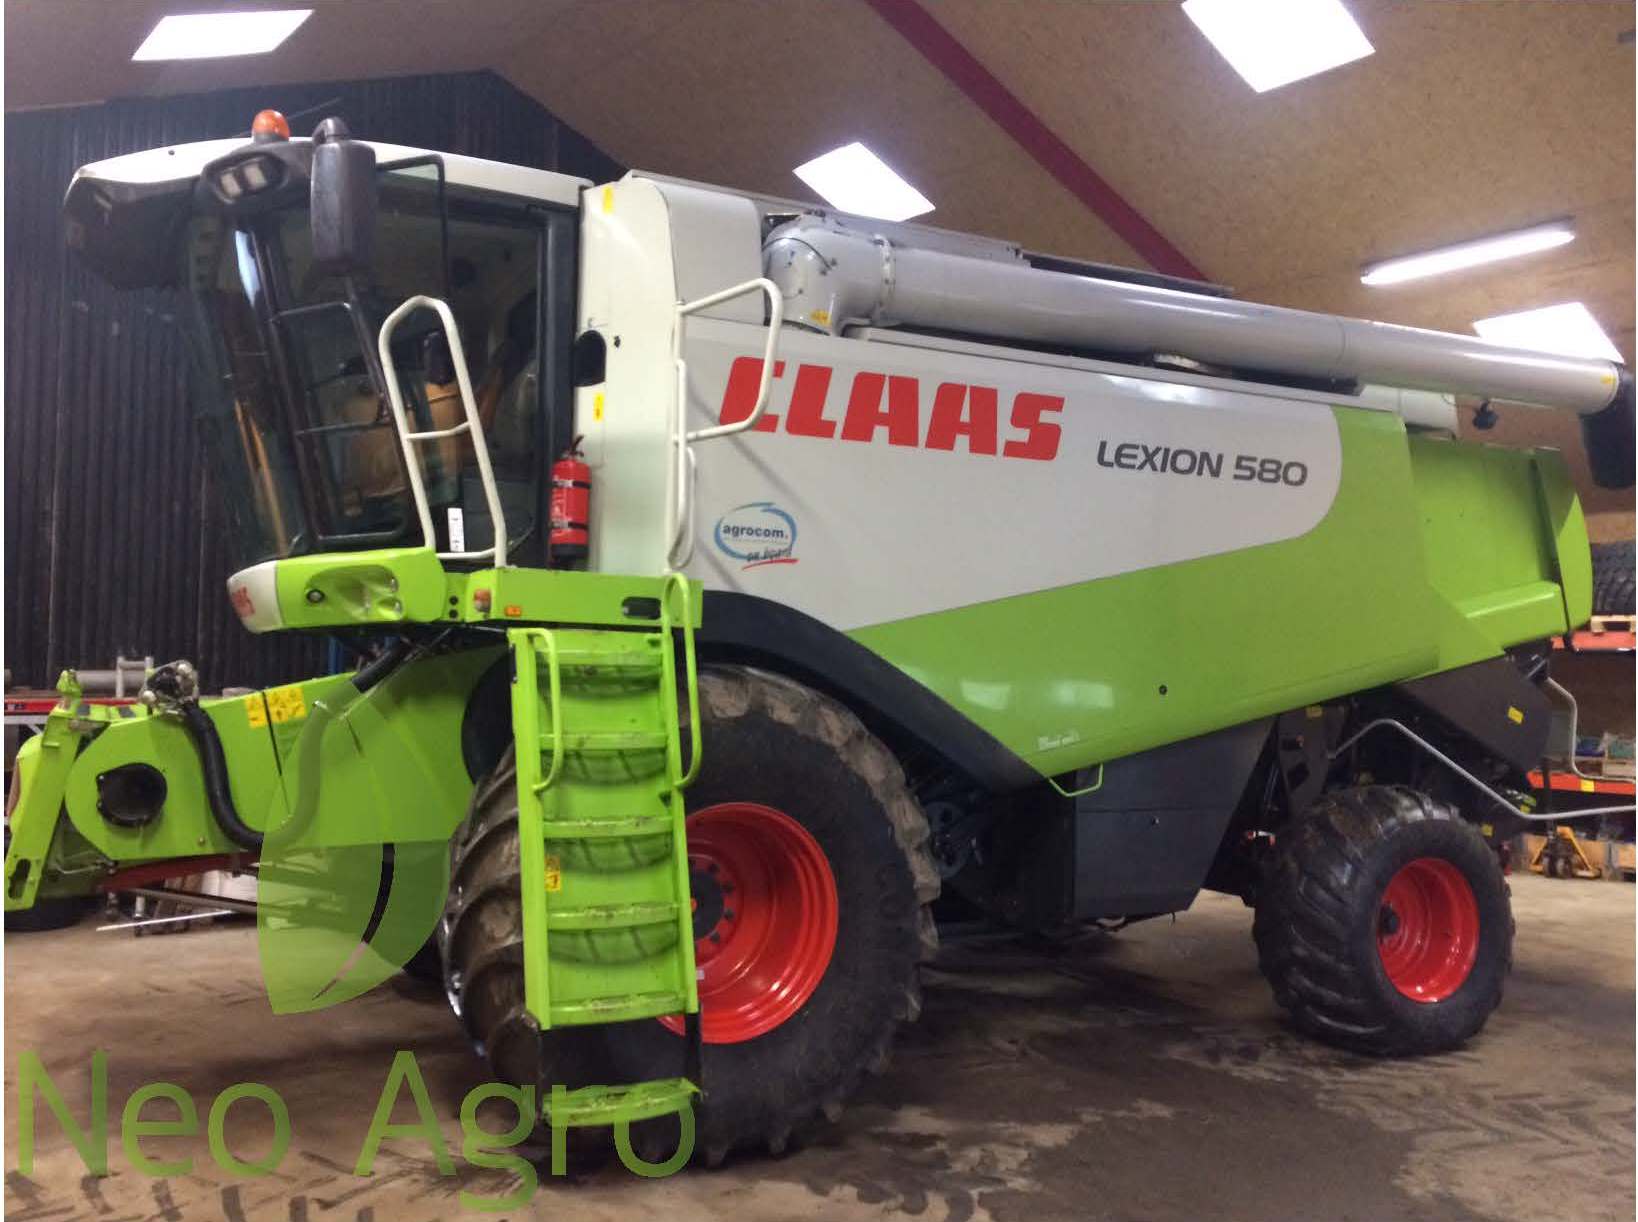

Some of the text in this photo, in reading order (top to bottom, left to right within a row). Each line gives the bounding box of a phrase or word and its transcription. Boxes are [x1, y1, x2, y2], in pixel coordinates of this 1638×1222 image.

[719, 356, 1065, 461] CLAAS
[1096, 440, 1308, 487] LEXION 580
